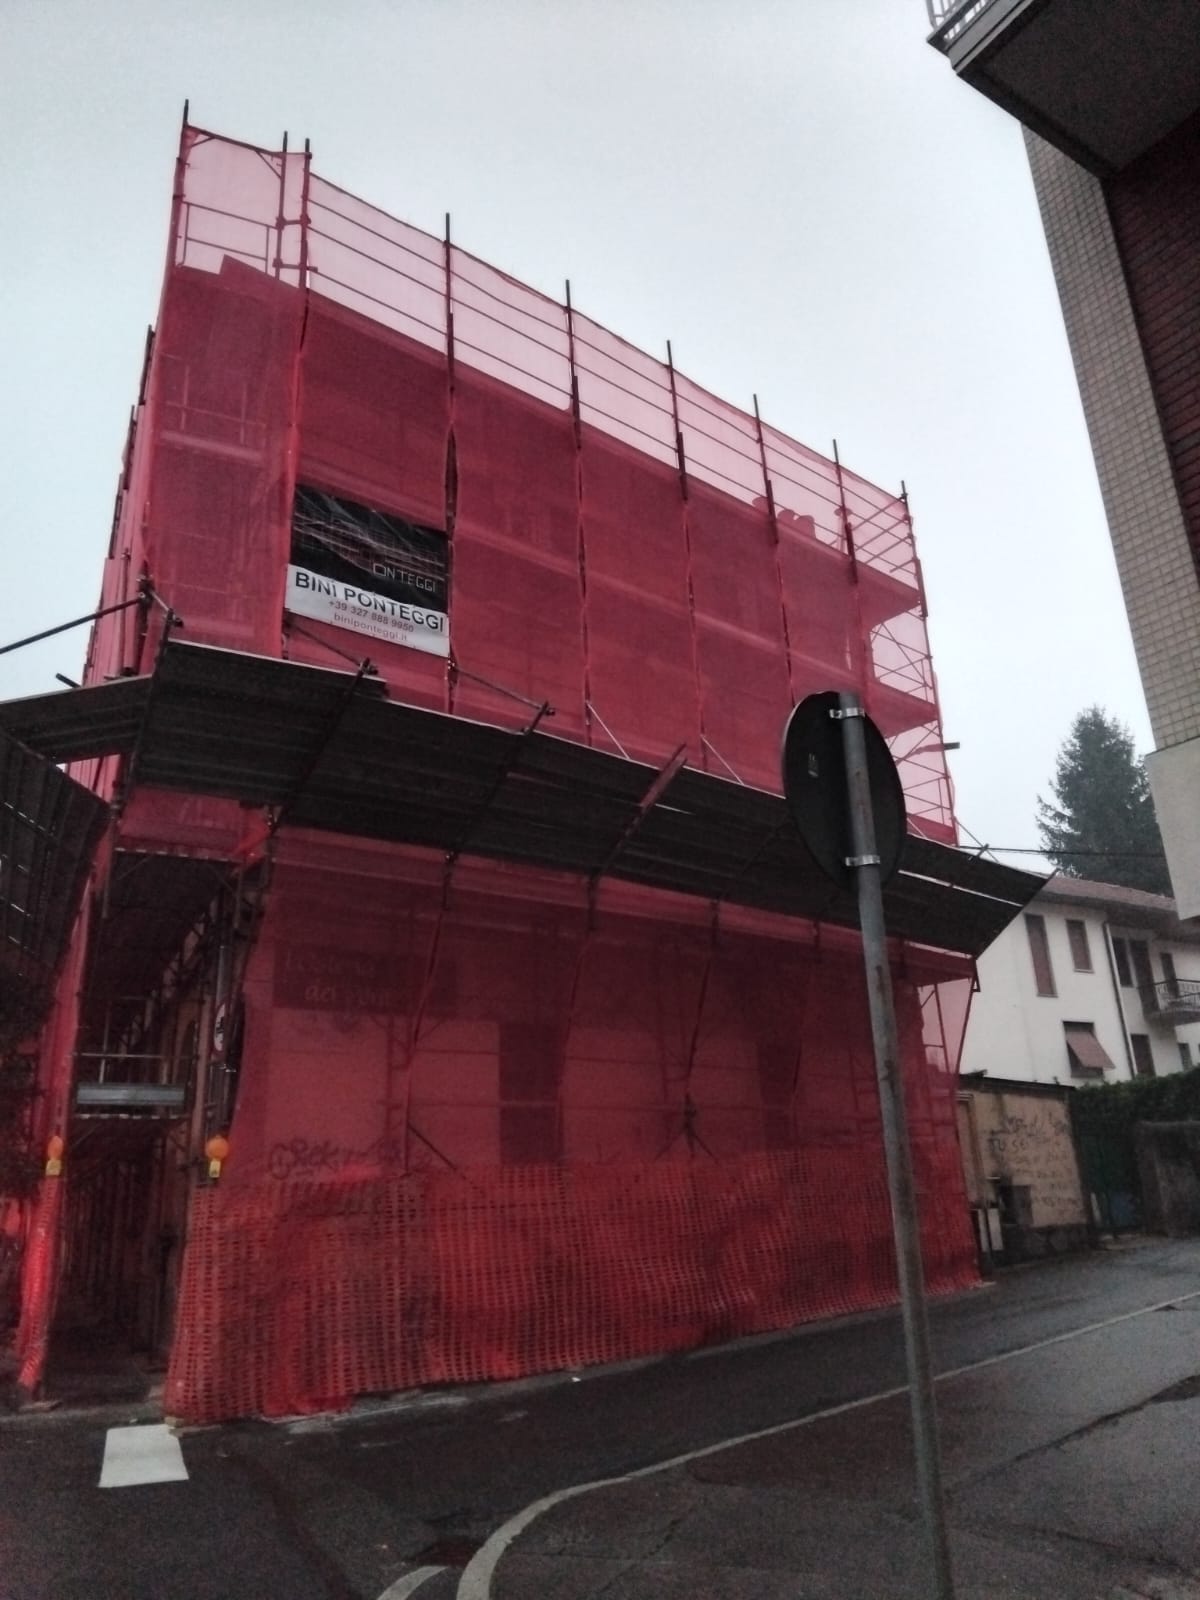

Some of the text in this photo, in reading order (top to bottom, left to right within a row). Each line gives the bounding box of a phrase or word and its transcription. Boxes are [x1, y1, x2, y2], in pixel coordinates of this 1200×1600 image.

[295, 572, 443, 632] BINI PONTEGGI
[328, 600, 348, 612] +39
[350, 606, 369, 618] 327
[334, 612, 408, 642] biniponteggi.it
